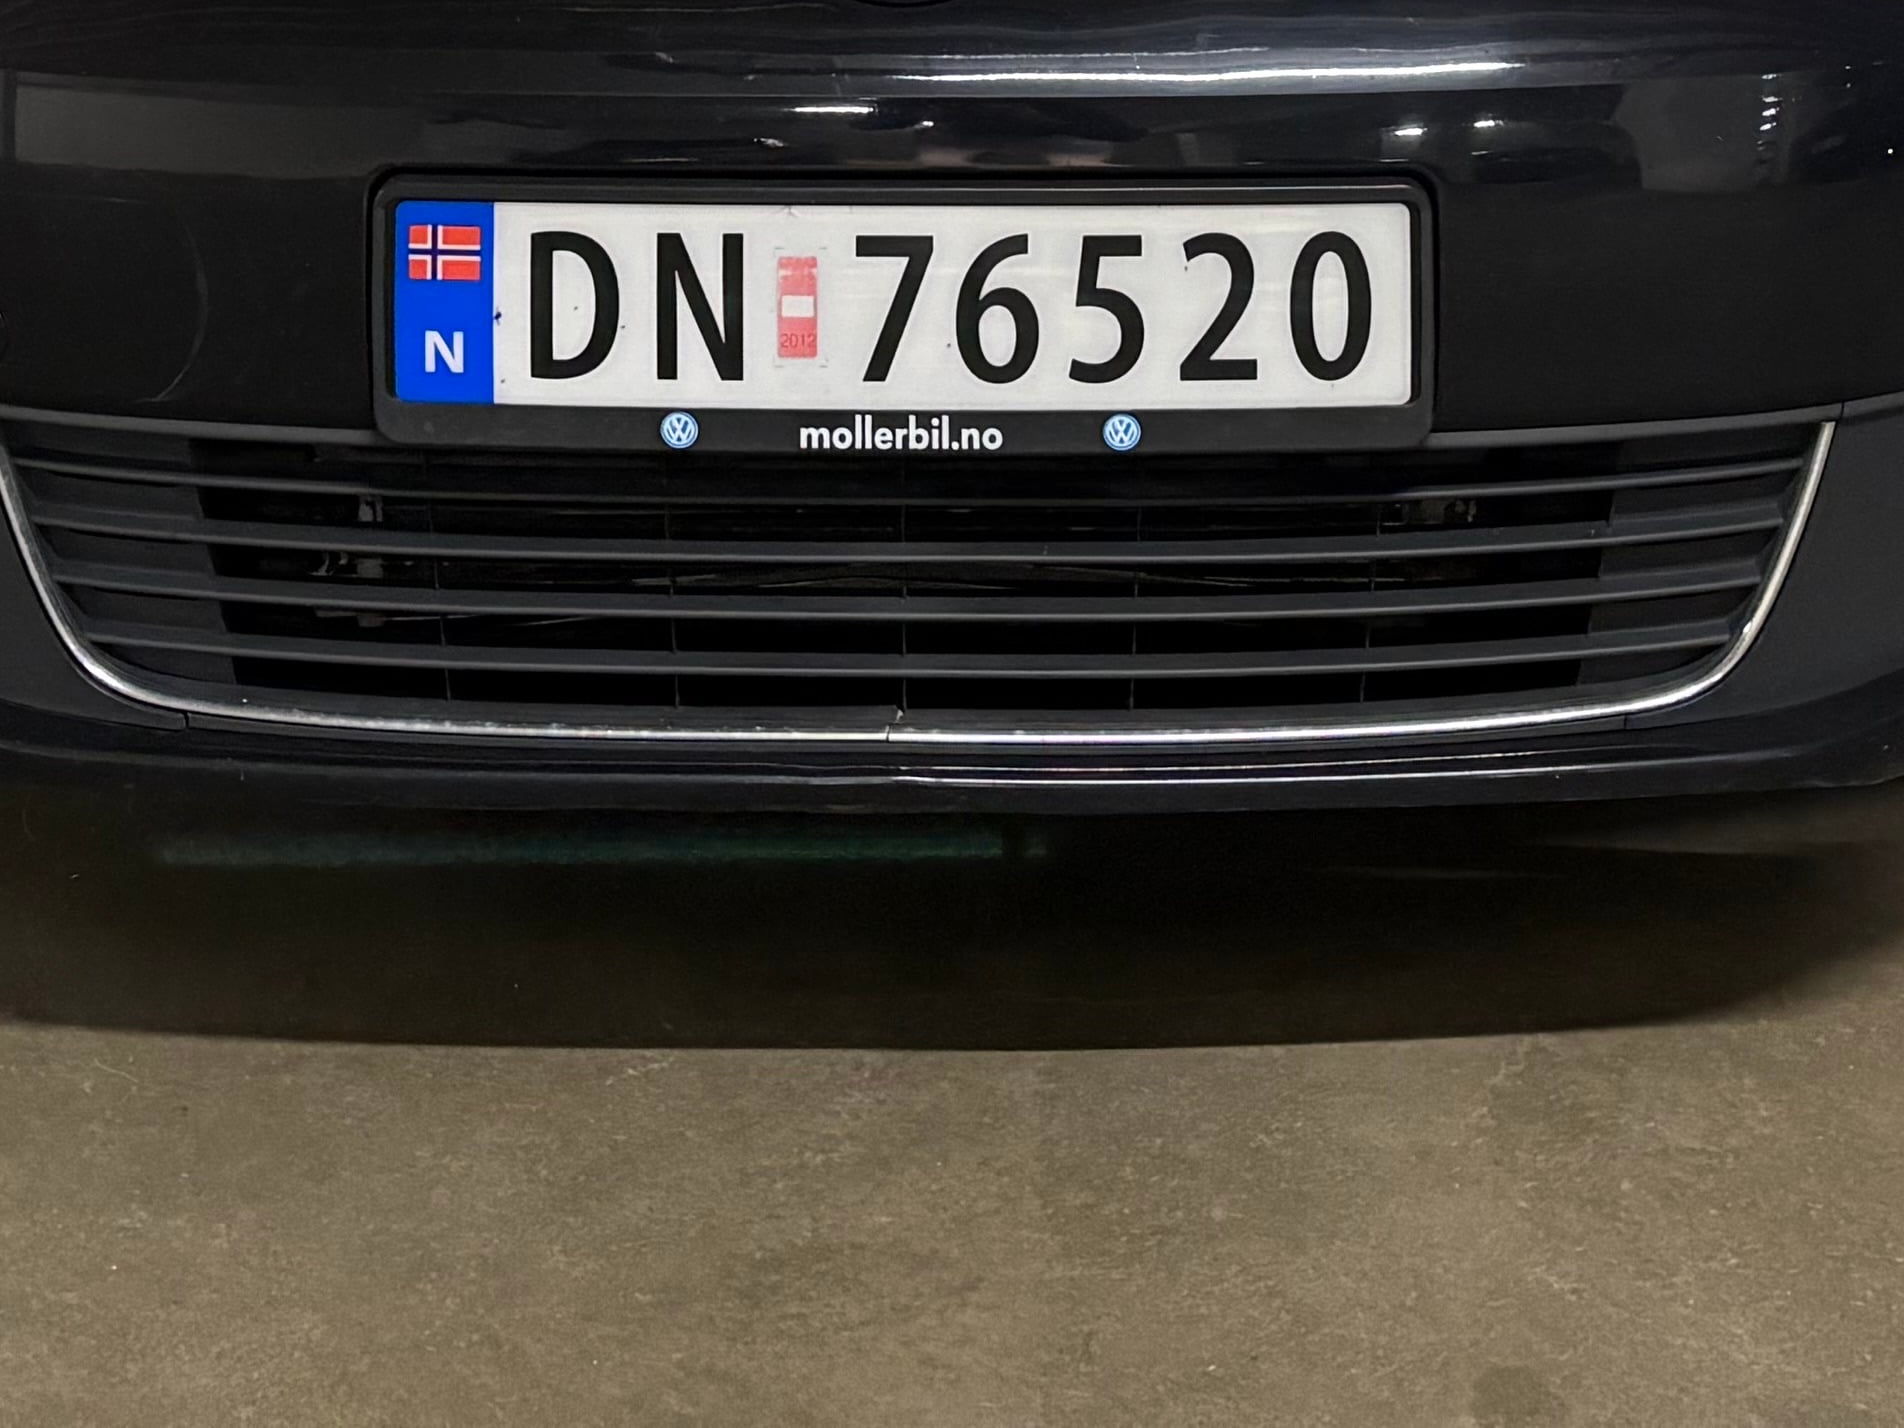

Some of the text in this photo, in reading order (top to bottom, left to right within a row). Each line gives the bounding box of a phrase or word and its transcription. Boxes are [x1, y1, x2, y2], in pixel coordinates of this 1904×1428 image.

[529, 230, 1372, 384] DN 76520
[424, 330, 464, 373] N
[781, 332, 816, 348] 2012
[799, 414, 1003, 451] mollerbil.no
